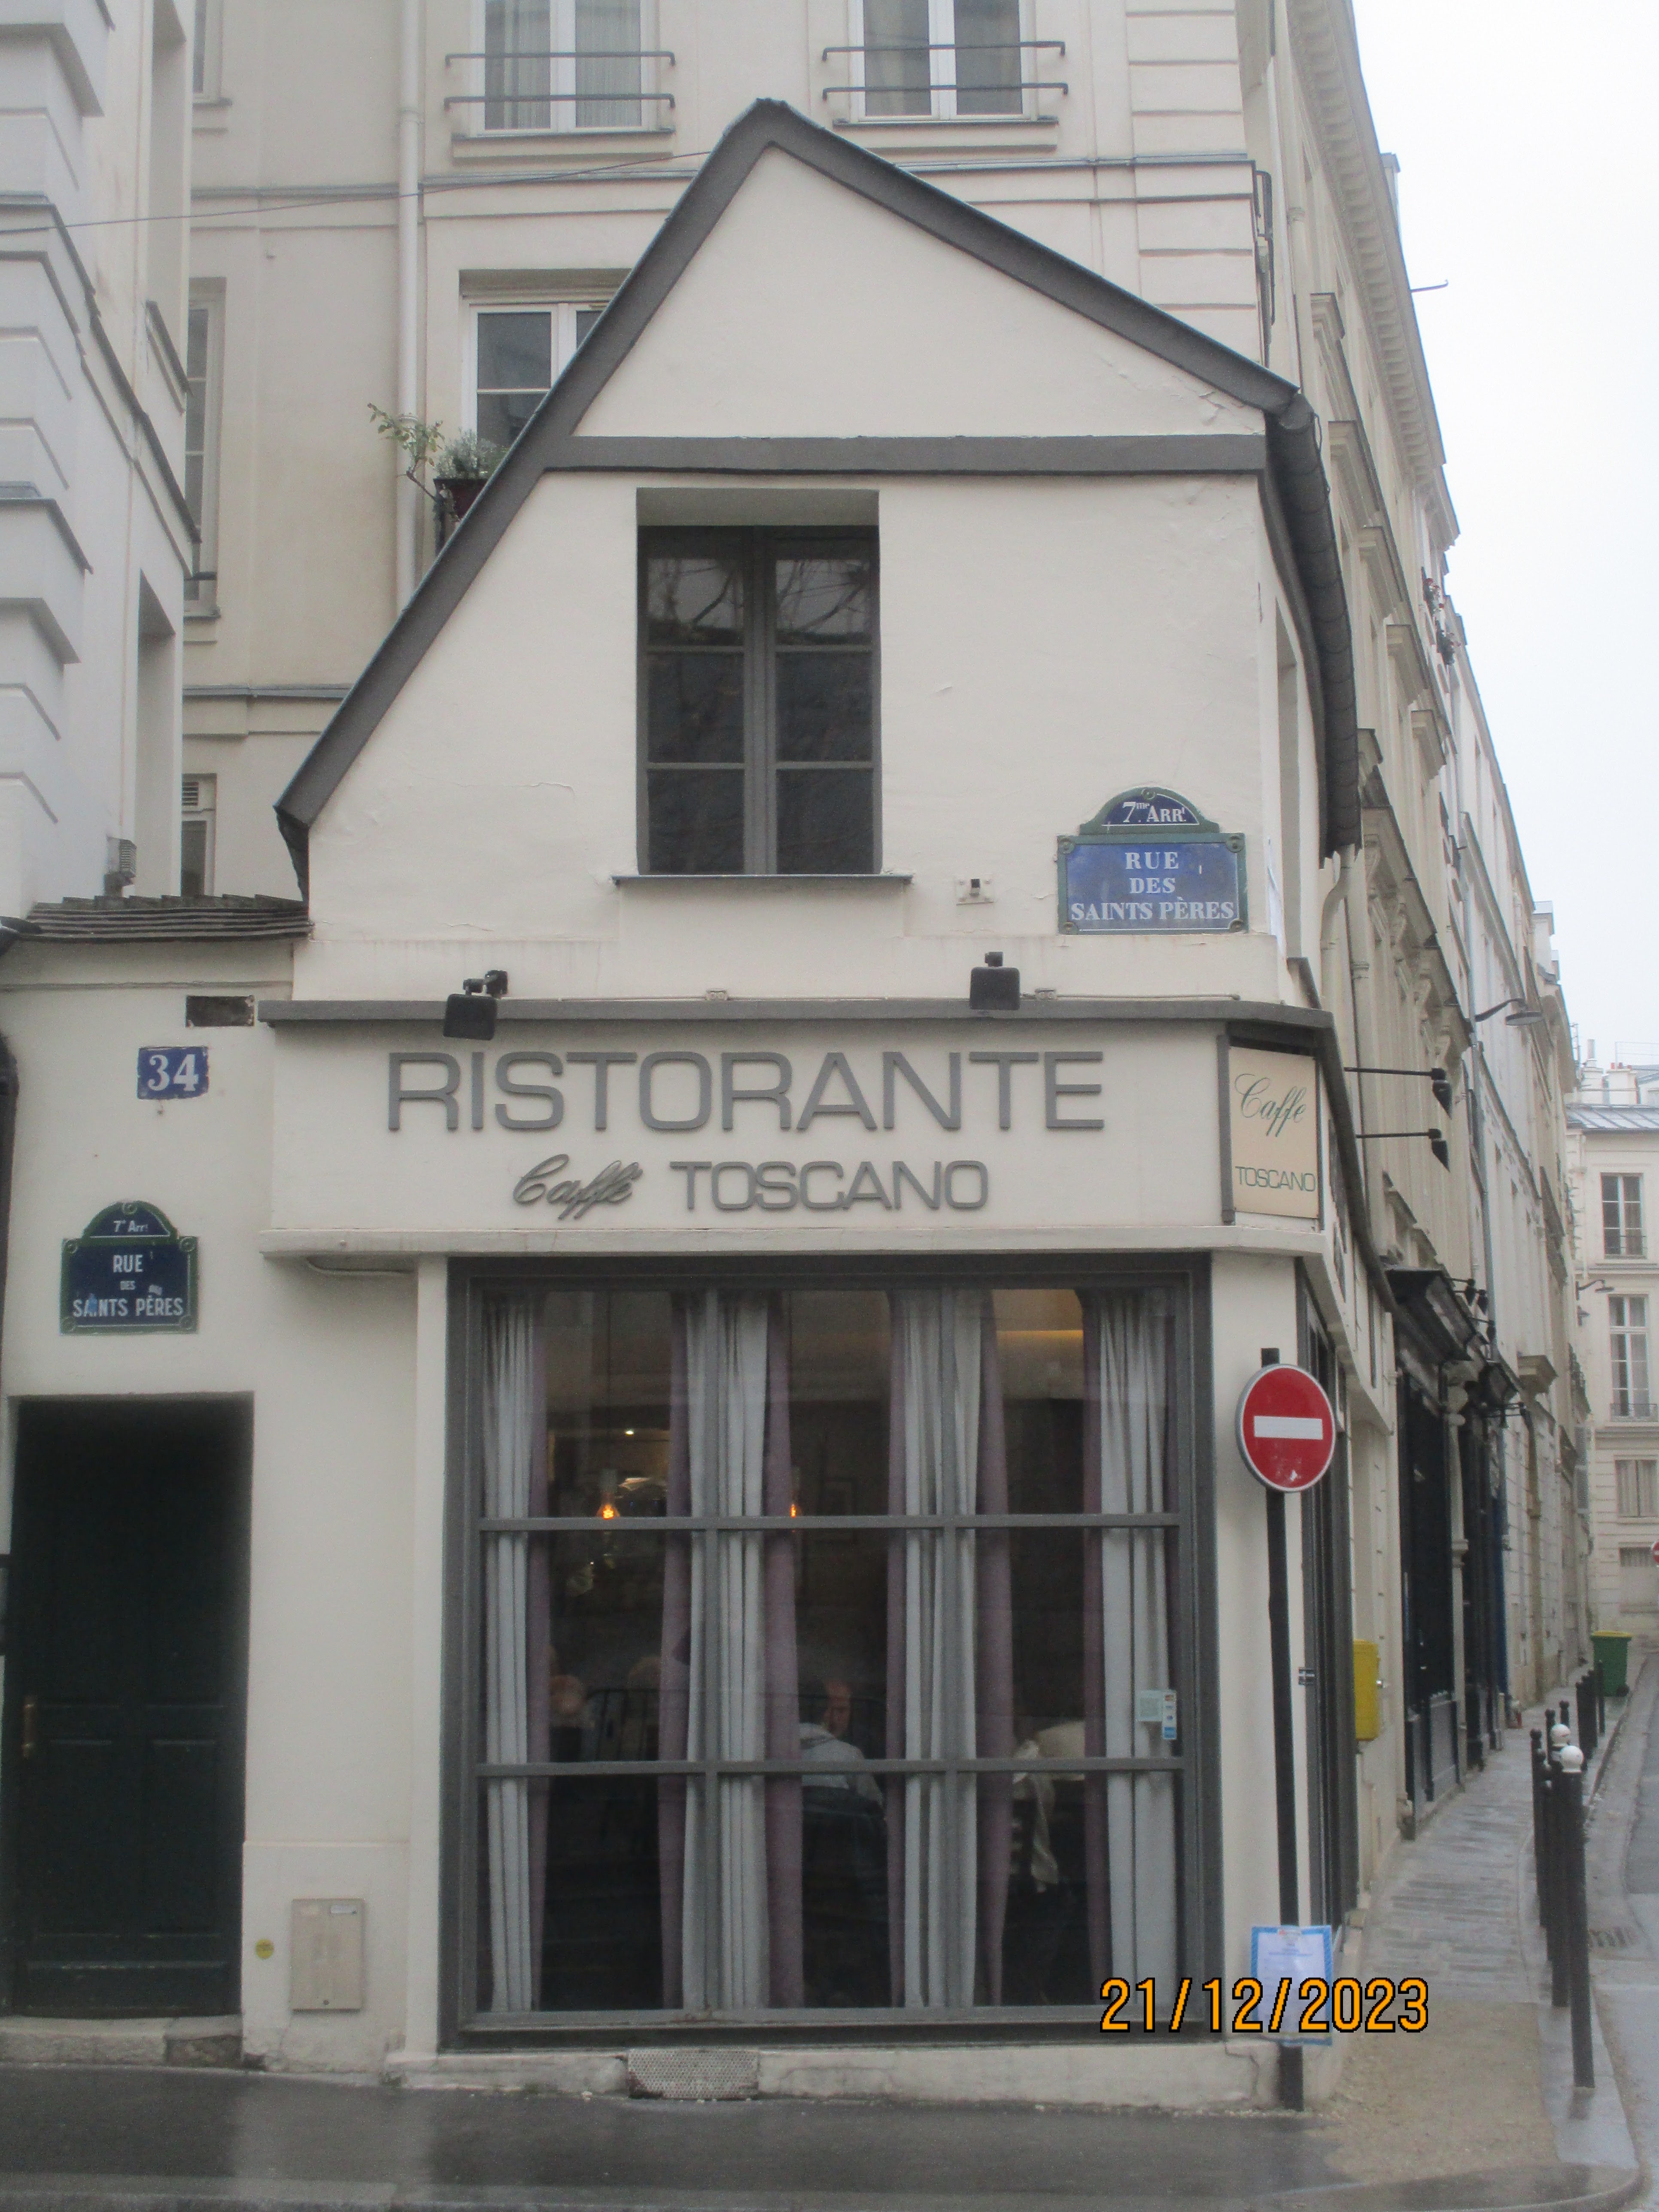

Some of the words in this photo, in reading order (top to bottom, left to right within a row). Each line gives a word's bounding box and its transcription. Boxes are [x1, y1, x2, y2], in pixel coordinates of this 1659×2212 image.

[1125, 852, 1179, 869] RUE
[1129, 878, 1176, 894] DES
[1071, 902, 1153, 920] SAINTS
[1159, 896, 1234, 920] PÈRES
[148, 1054, 199, 1091] 34
[388, 1051, 1105, 1131] RISTORANTE
[669, 1160, 989, 1210] TOSCANO
[1235, 1166, 1317, 1192] TOSCANO
[113, 1255, 144, 1273] RUE
